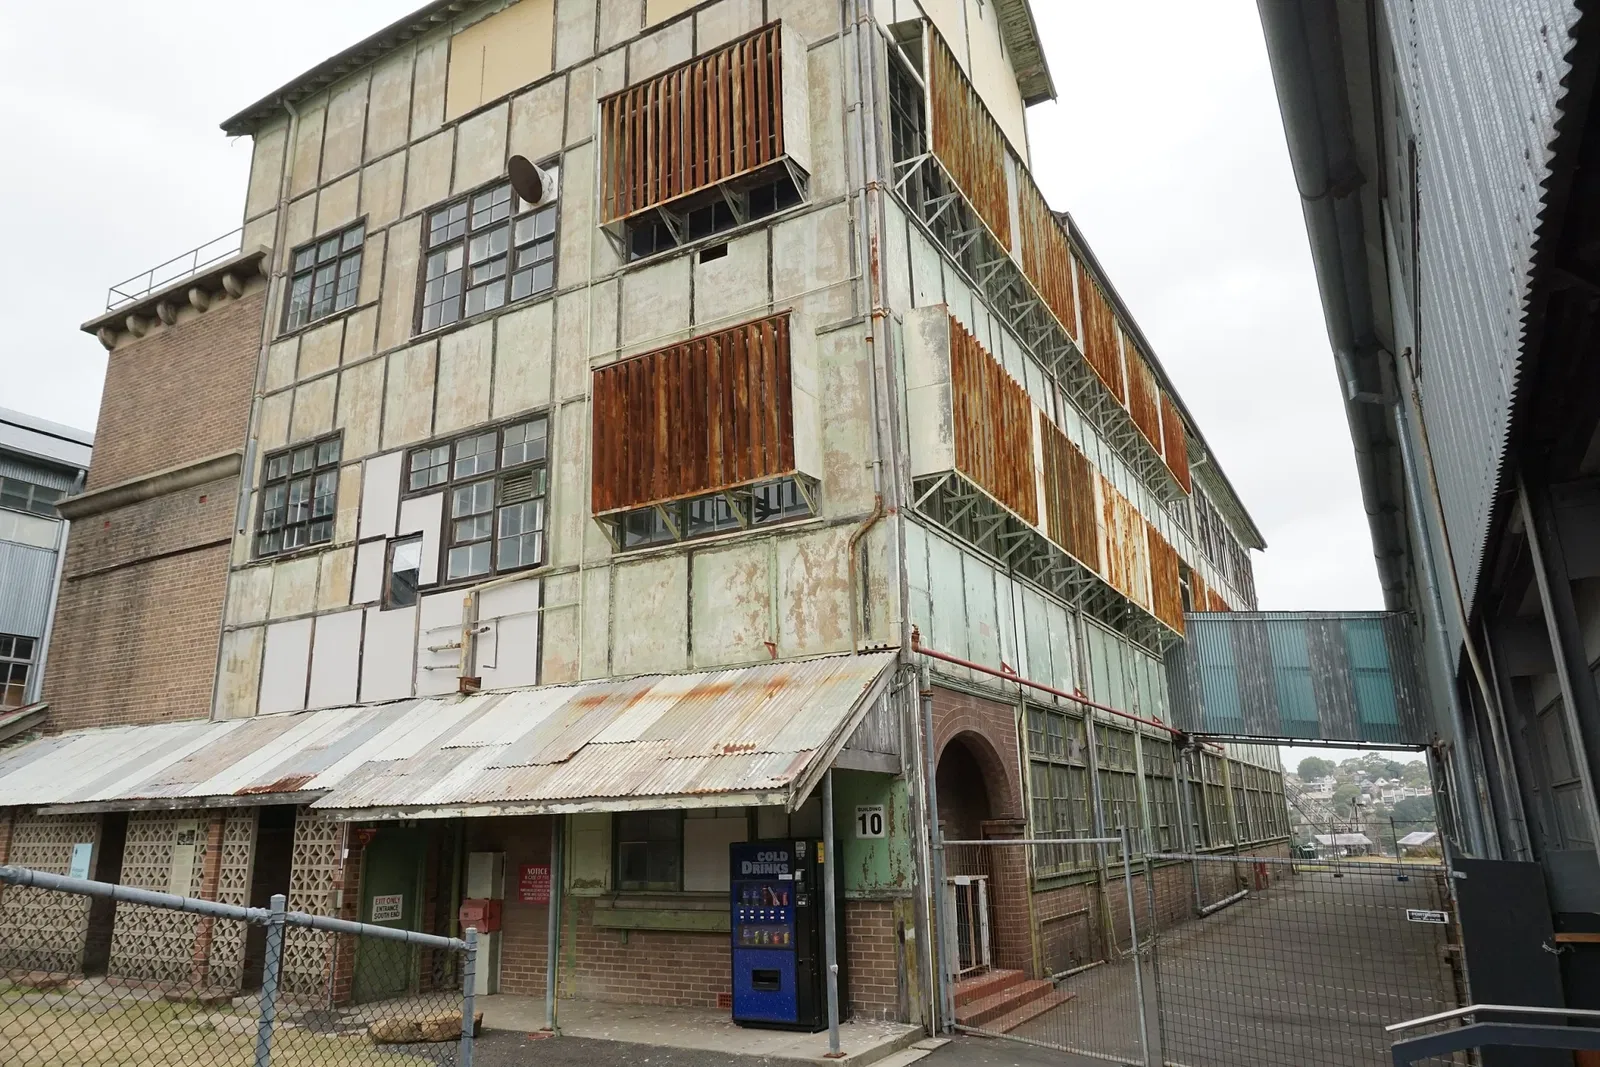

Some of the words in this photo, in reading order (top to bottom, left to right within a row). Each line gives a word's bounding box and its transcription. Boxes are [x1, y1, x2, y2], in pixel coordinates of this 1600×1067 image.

[858, 813, 882, 835] 10
[757, 851, 789, 862] COLD
[527, 867, 548, 875] NOTICE
[741, 861, 789, 875] DRINKS
[375, 897, 386, 905] EXIT
[376, 904, 399, 912] ENTRANCE
[373, 912, 389, 920] SOUTH
